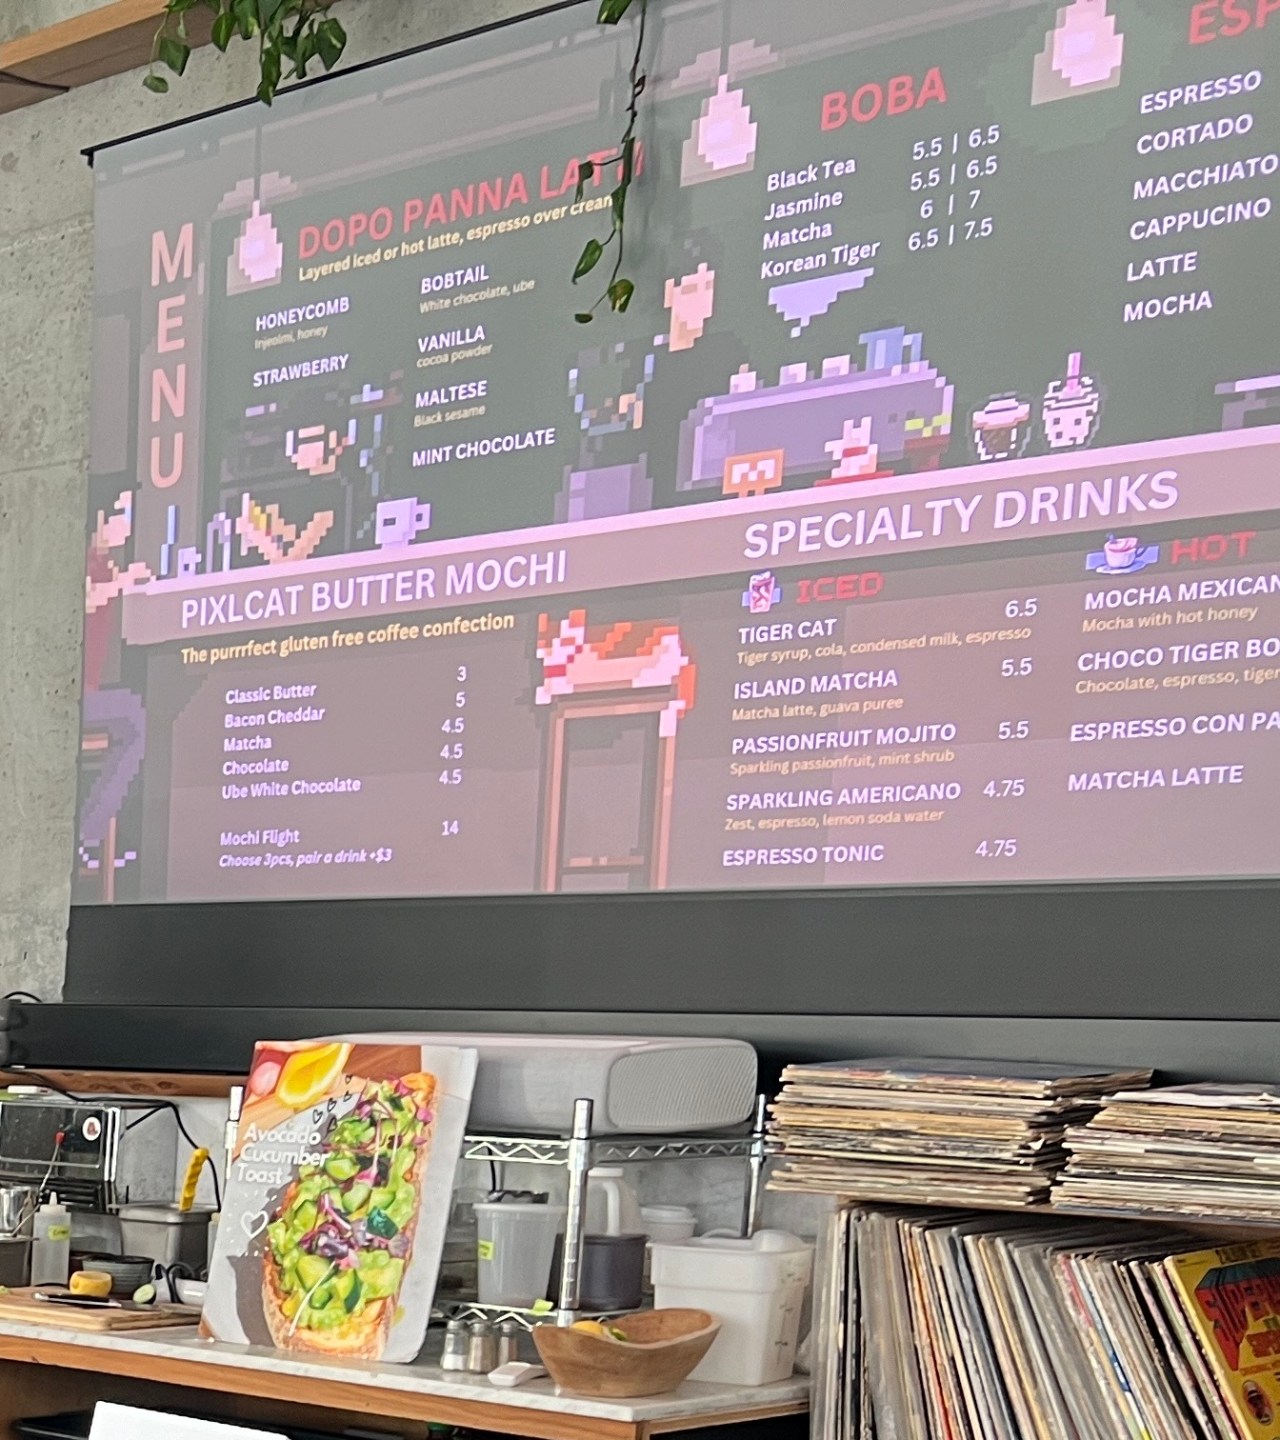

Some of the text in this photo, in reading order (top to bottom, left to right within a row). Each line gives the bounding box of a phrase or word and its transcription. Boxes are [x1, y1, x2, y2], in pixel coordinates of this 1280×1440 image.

[821, 66, 947, 131] BOBA
[1140, 70, 1262, 114] ESPRESSO
[913, 124, 1000, 161] 5.5 6.5
[1137, 113, 1253, 155] CORTADO
[767, 156, 856, 192] Black Tea
[910, 155, 998, 190] 5.5 6.5
[1133, 154, 1280, 200] MACCHIATO
[764, 188, 843, 222] Jasmine
[920, 189, 981, 219] 6 7
[1130, 197, 1272, 241] CAPPUCINO
[298, 186, 528, 260] DOPO PANNA
[763, 220, 832, 251] Matcha
[908, 217, 993, 251] 6.5 7.5
[299, 255, 350, 281] Layered
[383, 245, 398, 262] or
[401, 234, 424, 260] hot
[427, 226, 462, 256] latte,
[466, 212, 530, 248] espresso
[533, 206, 567, 225] over
[761, 240, 880, 279] Korean Tiger
[1126, 251, 1198, 281] LATTE
[421, 264, 489, 294] BOBTAIL
[419, 277, 535, 314] White chocolate, ube
[1124, 290, 1213, 323] MOCHA
[255, 296, 350, 332] HONEYCOMB
[297, 323, 328, 344] honey
[417, 325, 485, 353] VANILLA
[151, 223, 193, 487] MENU
[417, 342, 493, 370] cocoa powder
[253, 354, 350, 387] STRAWBERRY
[416, 380, 488, 408] MALTESE
[414, 403, 486, 428] Black sesame
[412, 427, 556, 467] MINT CHOCOLATE
[743, 470, 1179, 559] SPECIALTY DRINKS
[1172, 532, 1256, 564] HOT
[182, 549, 567, 629] PIXLCAT BUTTER MOCHI
[796, 571, 884, 603] ICED
[1084, 586, 1172, 611] MOCHA
[738, 598, 1037, 644] TIGER CAT 6.5
[1082, 605, 1258, 633] Mocha with hot honey
[181, 646, 207, 665] The
[280, 631, 328, 657] gluten
[331, 627, 364, 649] free
[367, 621, 419, 643] coffee
[423, 611, 515, 638] confection
[738, 625, 1032, 668] Tiger syrup, cola, condensed milk, espresso
[1078, 647, 1164, 672] CHOCO
[1169, 639, 1240, 665] TIGER
[457, 666, 467, 682] 3
[734, 657, 1033, 700] ISLAND MATCHA 5.5
[1075, 676, 1159, 695] Chocolate,
[1162, 672, 1239, 691] espresso,
[225, 681, 317, 704] Classic Butter
[455, 691, 465, 707] 5
[224, 705, 325, 728] Bacon Cheddar
[732, 697, 904, 721] Matcha latte, guava puree
[442, 718, 464, 735] 4.5
[732, 720, 1029, 755] PASSIONFRUIT MOJITO 5.5
[1070, 715, 1243, 742] ESPRESSO CON
[223, 734, 272, 752] Matcha
[440, 743, 463, 760] 4.5
[223, 756, 289, 776] Chocolate
[439, 768, 462, 785] 4.5
[730, 748, 955, 777] Sparkling passionfruit, mint shrub
[221, 775, 361, 799] Ube White Chocolate
[1067, 764, 1243, 792] MATCHA LATTE
[726, 778, 1025, 812] SPARKLING AMERICANO 4.75
[442, 820, 459, 836] 14
[724, 809, 945, 831] Zest, espresso, lemon soda water
[220, 828, 300, 847] Mochi Flight
[219, 852, 262, 868] Choose
[296, 850, 321, 868] pair
[335, 849, 367, 865] drink
[722, 839, 1017, 867] ESPRESSO TONIC 4.75
[244, 1122, 320, 1145] Avocado
[240, 1145, 328, 1167] Cucumber
[237, 1163, 282, 1184] Toast
